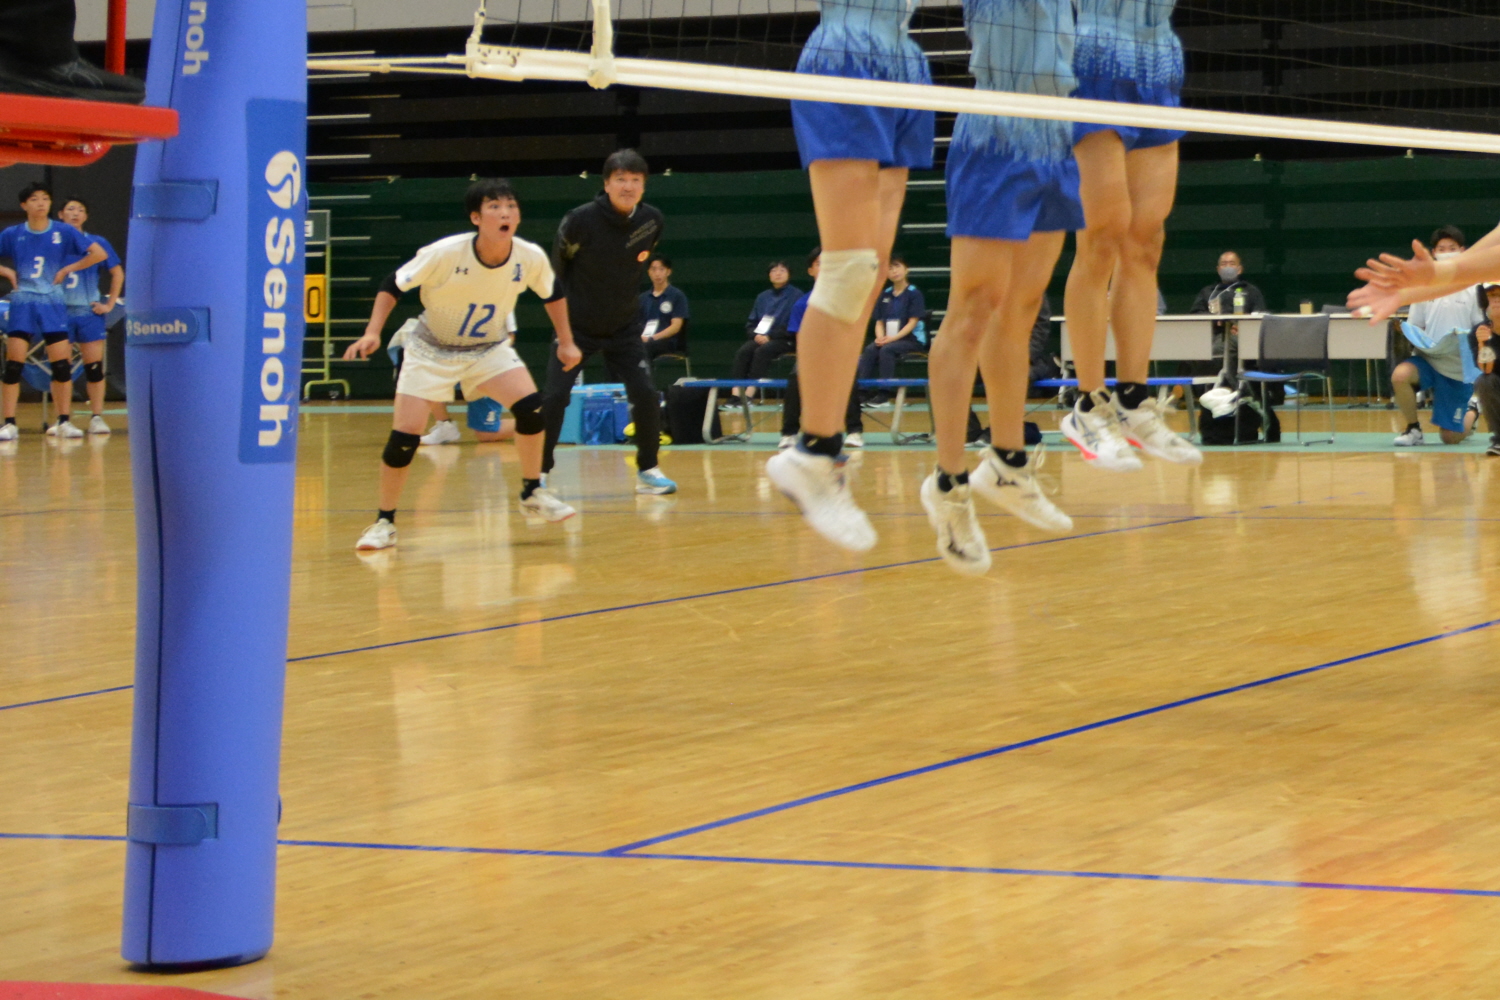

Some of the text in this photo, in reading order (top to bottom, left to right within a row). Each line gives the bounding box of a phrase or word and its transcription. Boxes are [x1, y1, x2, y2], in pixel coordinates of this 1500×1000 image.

[30, 256, 45, 279] 3
[133, 319, 189, 337] Senoh
[257, 216, 296, 447] Senoh
[457, 303, 497, 338] 12
